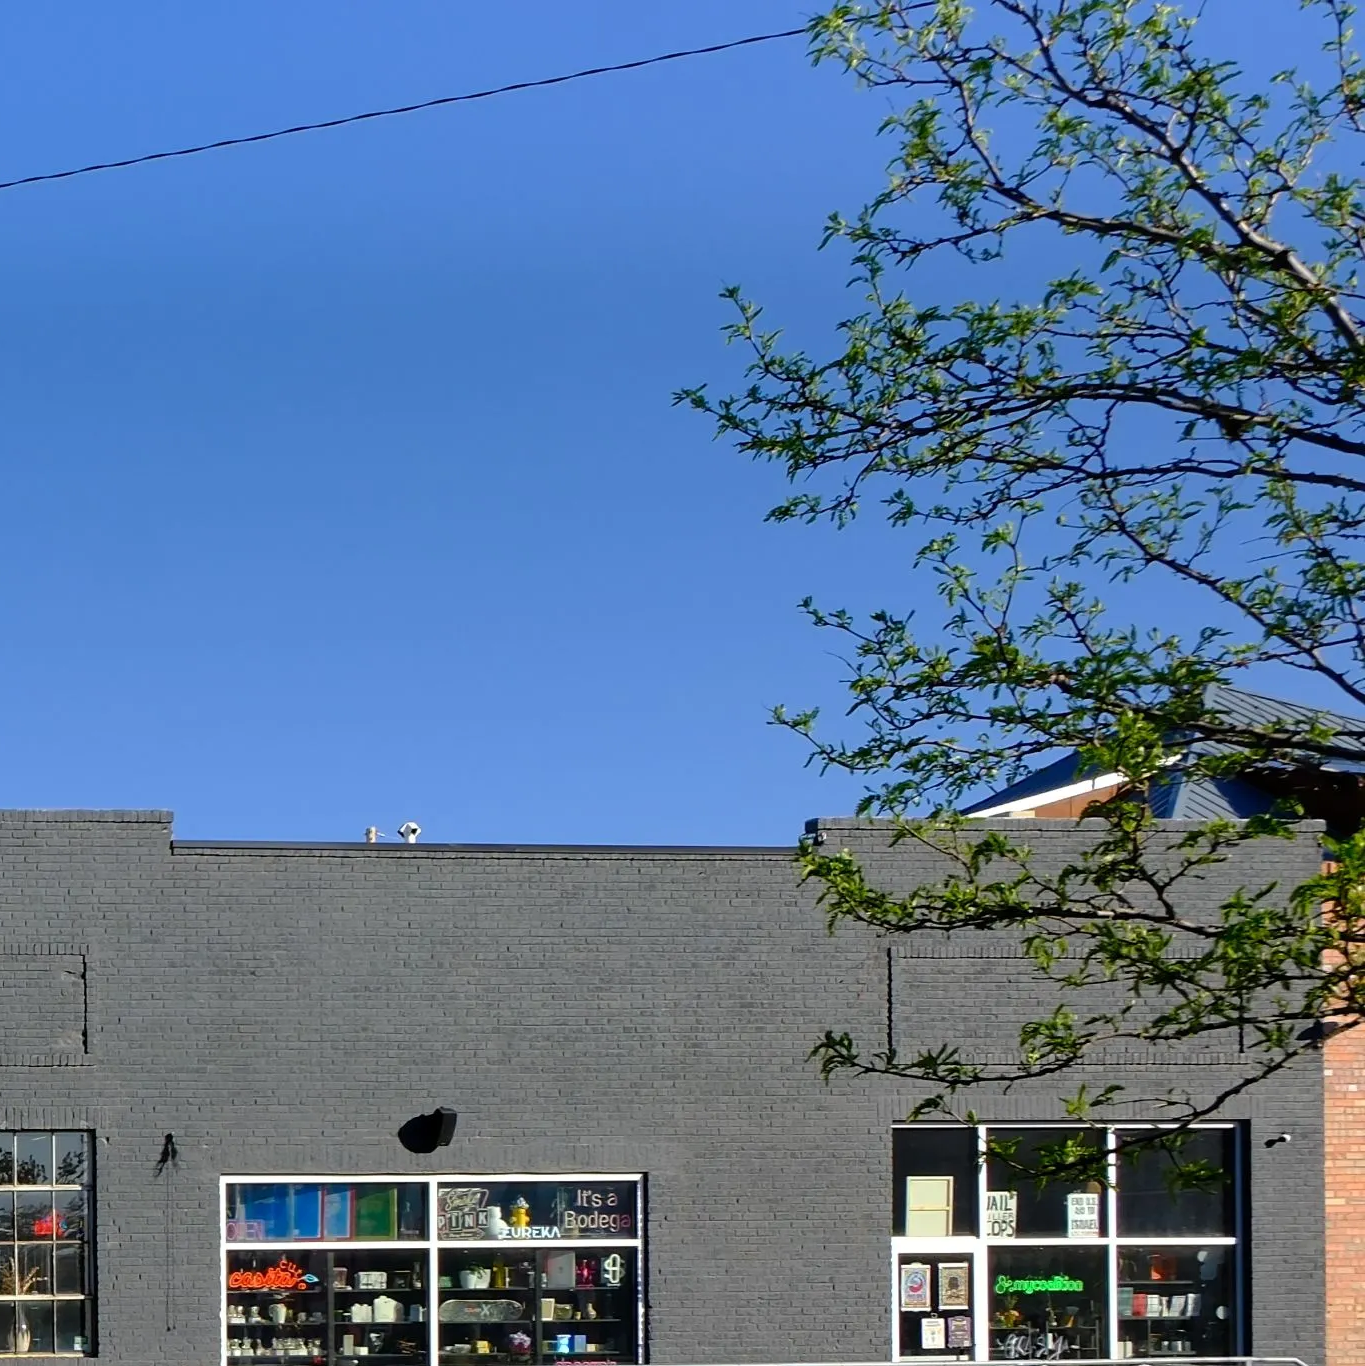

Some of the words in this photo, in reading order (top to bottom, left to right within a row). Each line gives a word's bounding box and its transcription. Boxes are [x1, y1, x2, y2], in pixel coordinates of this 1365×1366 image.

[576, 1189, 603, 1208] It's
[607, 1192, 618, 1206] a
[564, 1211, 631, 1232] Bodega
[501, 1226, 561, 1239] EUREKA
